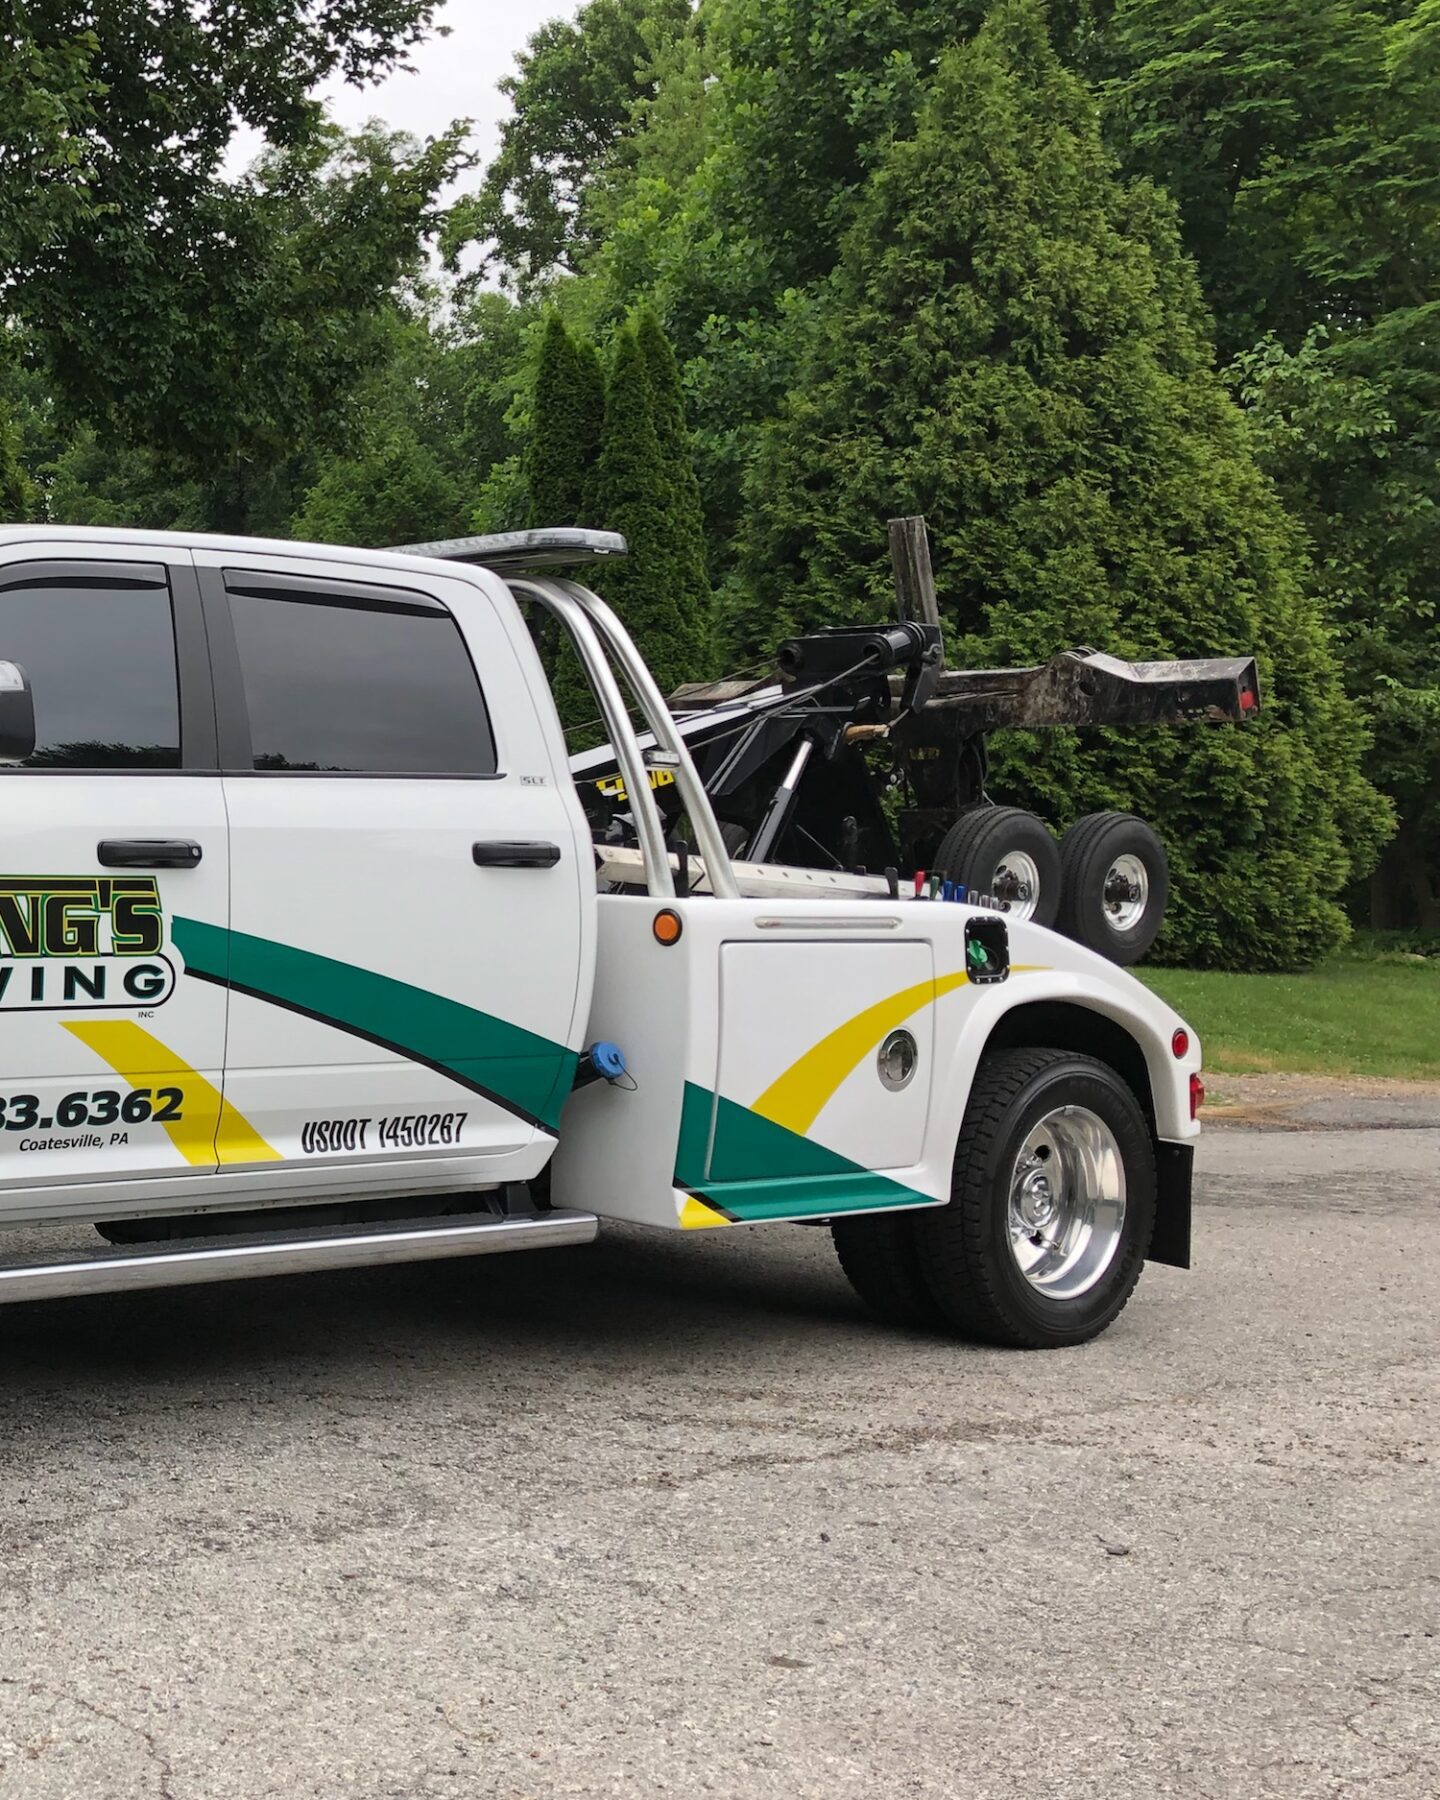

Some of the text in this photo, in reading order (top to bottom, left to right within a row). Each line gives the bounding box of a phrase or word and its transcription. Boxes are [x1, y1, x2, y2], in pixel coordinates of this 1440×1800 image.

[137, 1010, 155, 1019] INC
[18, 1133, 104, 1153] Coatesville,
[109, 1132, 129, 1146] PA
[301, 1112, 469, 1154] USDOT 1450267
